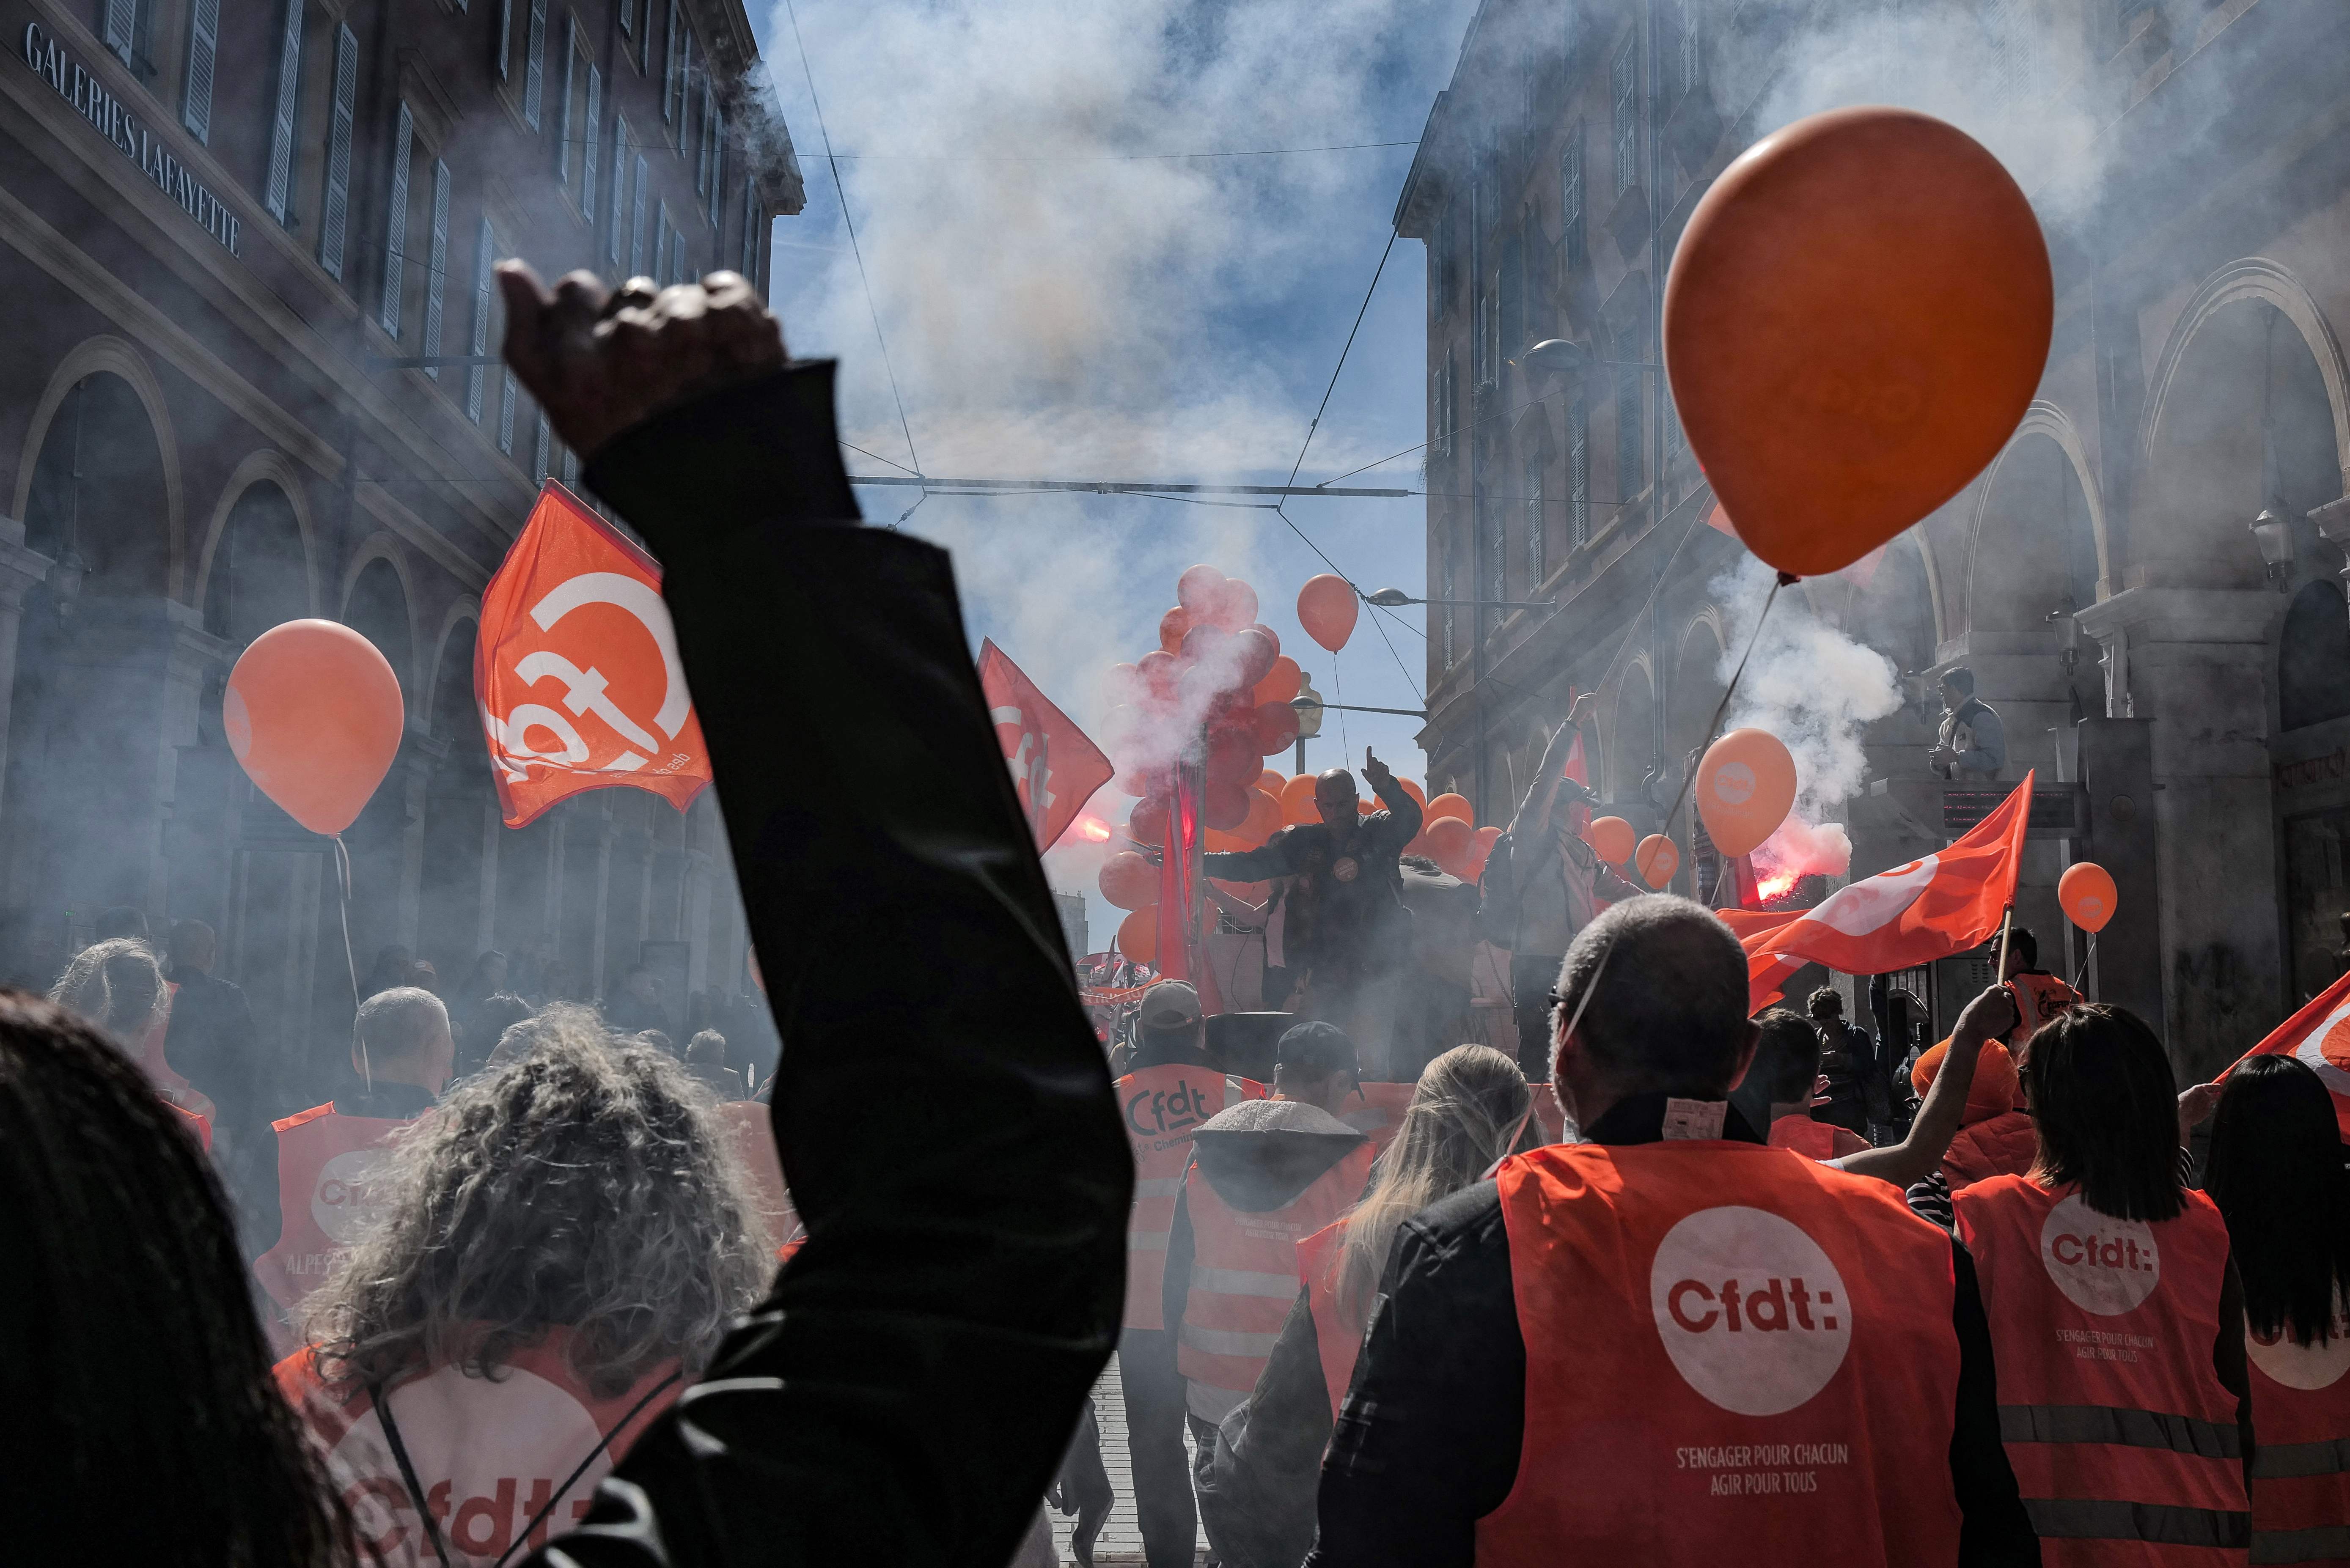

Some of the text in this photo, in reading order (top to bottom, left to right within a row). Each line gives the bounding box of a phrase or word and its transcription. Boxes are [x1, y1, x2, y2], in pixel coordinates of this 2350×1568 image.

[26, 22, 240, 258] GALERIES LAFAYETTE
[1153, 1132, 1193, 1151] Chemin
[2051, 1233, 2153, 1271] Cfdt:
[1667, 1277, 1838, 1333] Cfdt:
[2056, 1329, 2154, 1348] S'ENGAGER POUR CHACUN
[2076, 1346, 2138, 1363] AGIR POUR TOUS
[1676, 1443, 1848, 1469] S'ENGAGER POUR CHACUN
[1710, 1471, 1817, 1496] AGIR POUR TOUS
